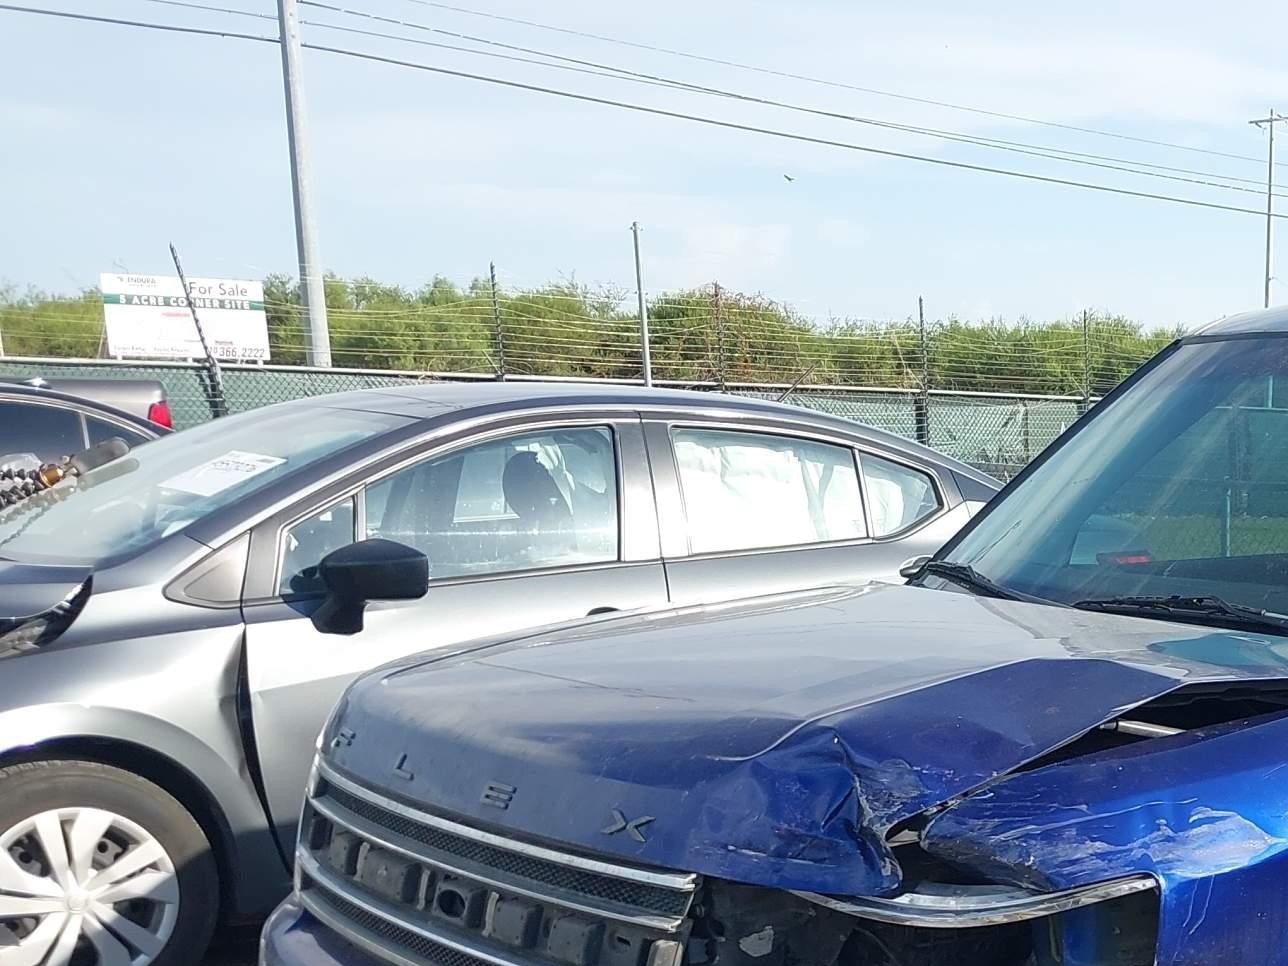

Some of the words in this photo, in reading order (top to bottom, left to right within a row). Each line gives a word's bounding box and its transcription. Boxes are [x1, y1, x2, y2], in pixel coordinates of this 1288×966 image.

[188, 281, 214, 295] For
[218, 283, 248, 297] Sale
[132, 295, 165, 306] ACRE
[169, 297, 221, 309] CONER
[224, 300, 251, 310] SITE
